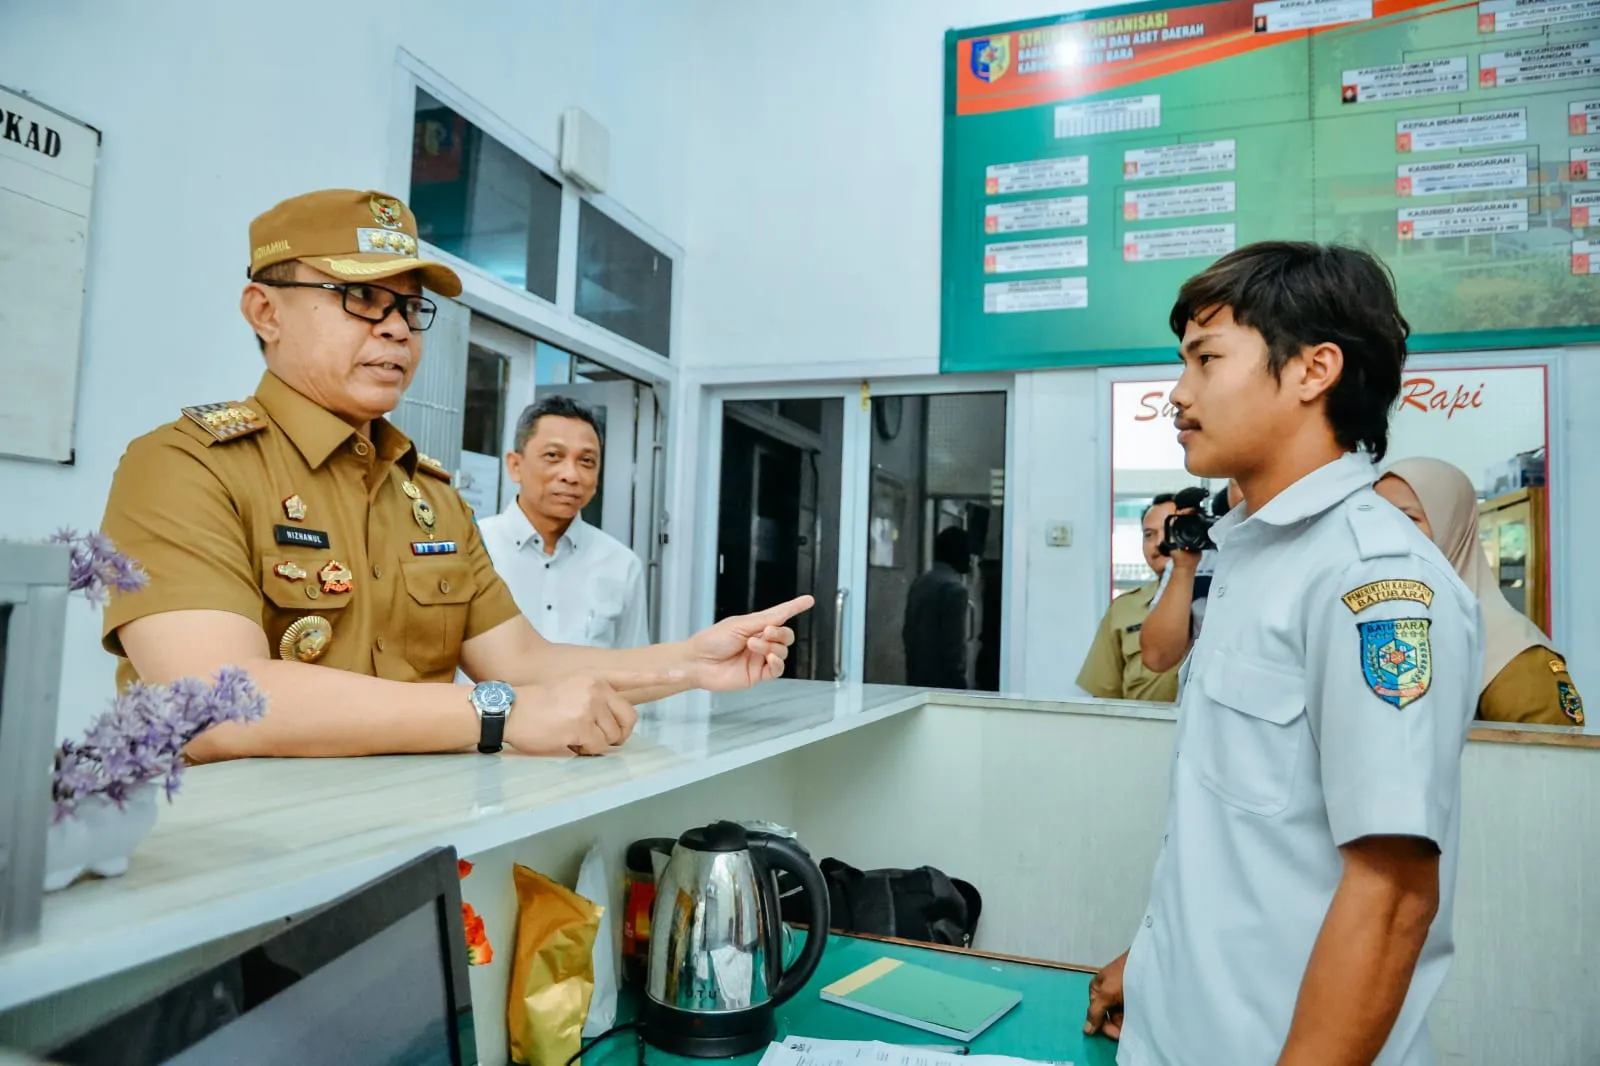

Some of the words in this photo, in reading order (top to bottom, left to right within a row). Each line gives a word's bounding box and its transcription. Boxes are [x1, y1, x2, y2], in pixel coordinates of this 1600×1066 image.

[1088, 12, 1168, 36] ORGANISASI
[1109, 34, 1131, 48] DAN
[1133, 30, 1159, 44] ASET
[1161, 23, 1204, 41] DAERAH
[1107, 47, 1134, 61] BARA
[0, 108, 61, 158] KAD
[1398, 378, 1485, 420] Rapi
[1346, 582, 1390, 604] PEMERINTAH
[1357, 589, 1426, 607] BATUBARA
